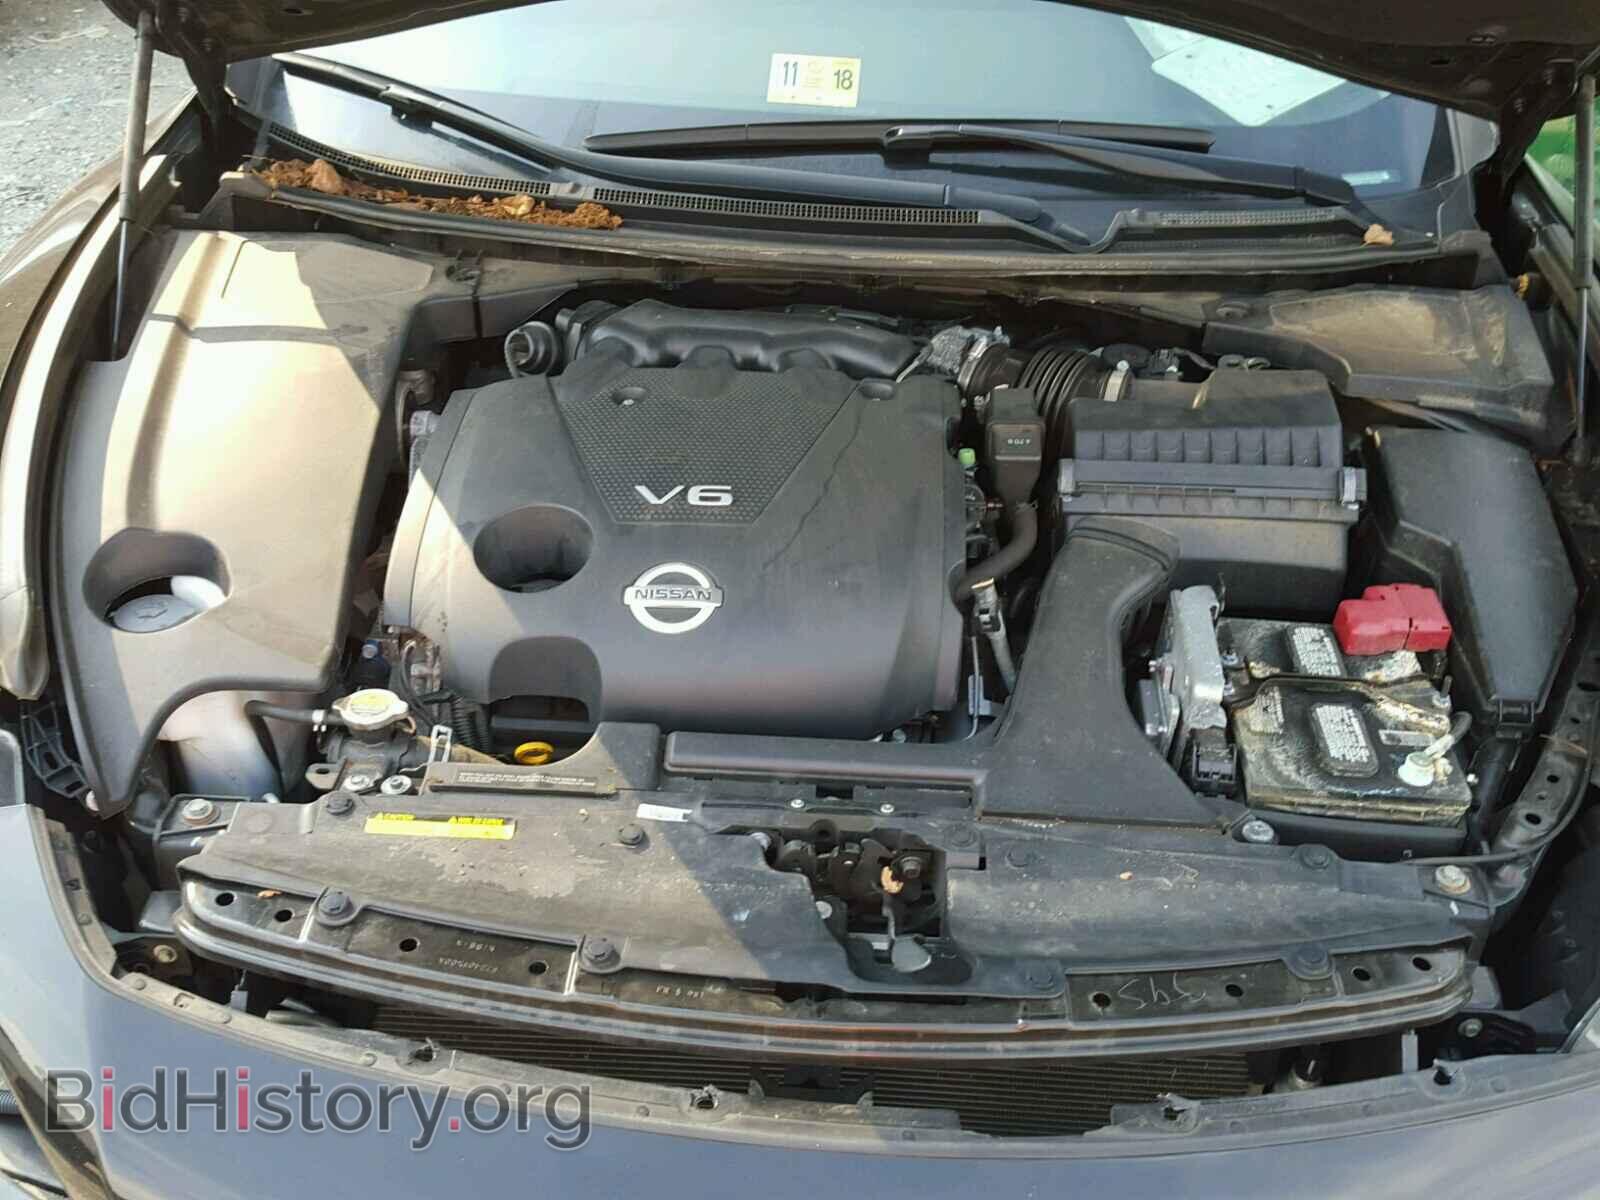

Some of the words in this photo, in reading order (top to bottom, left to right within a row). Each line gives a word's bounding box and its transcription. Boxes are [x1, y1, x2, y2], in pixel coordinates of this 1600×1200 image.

[783, 61, 798, 87] 11
[833, 68, 853, 90] 18
[634, 484, 734, 506] V6
[634, 588, 712, 601] NISSAN
